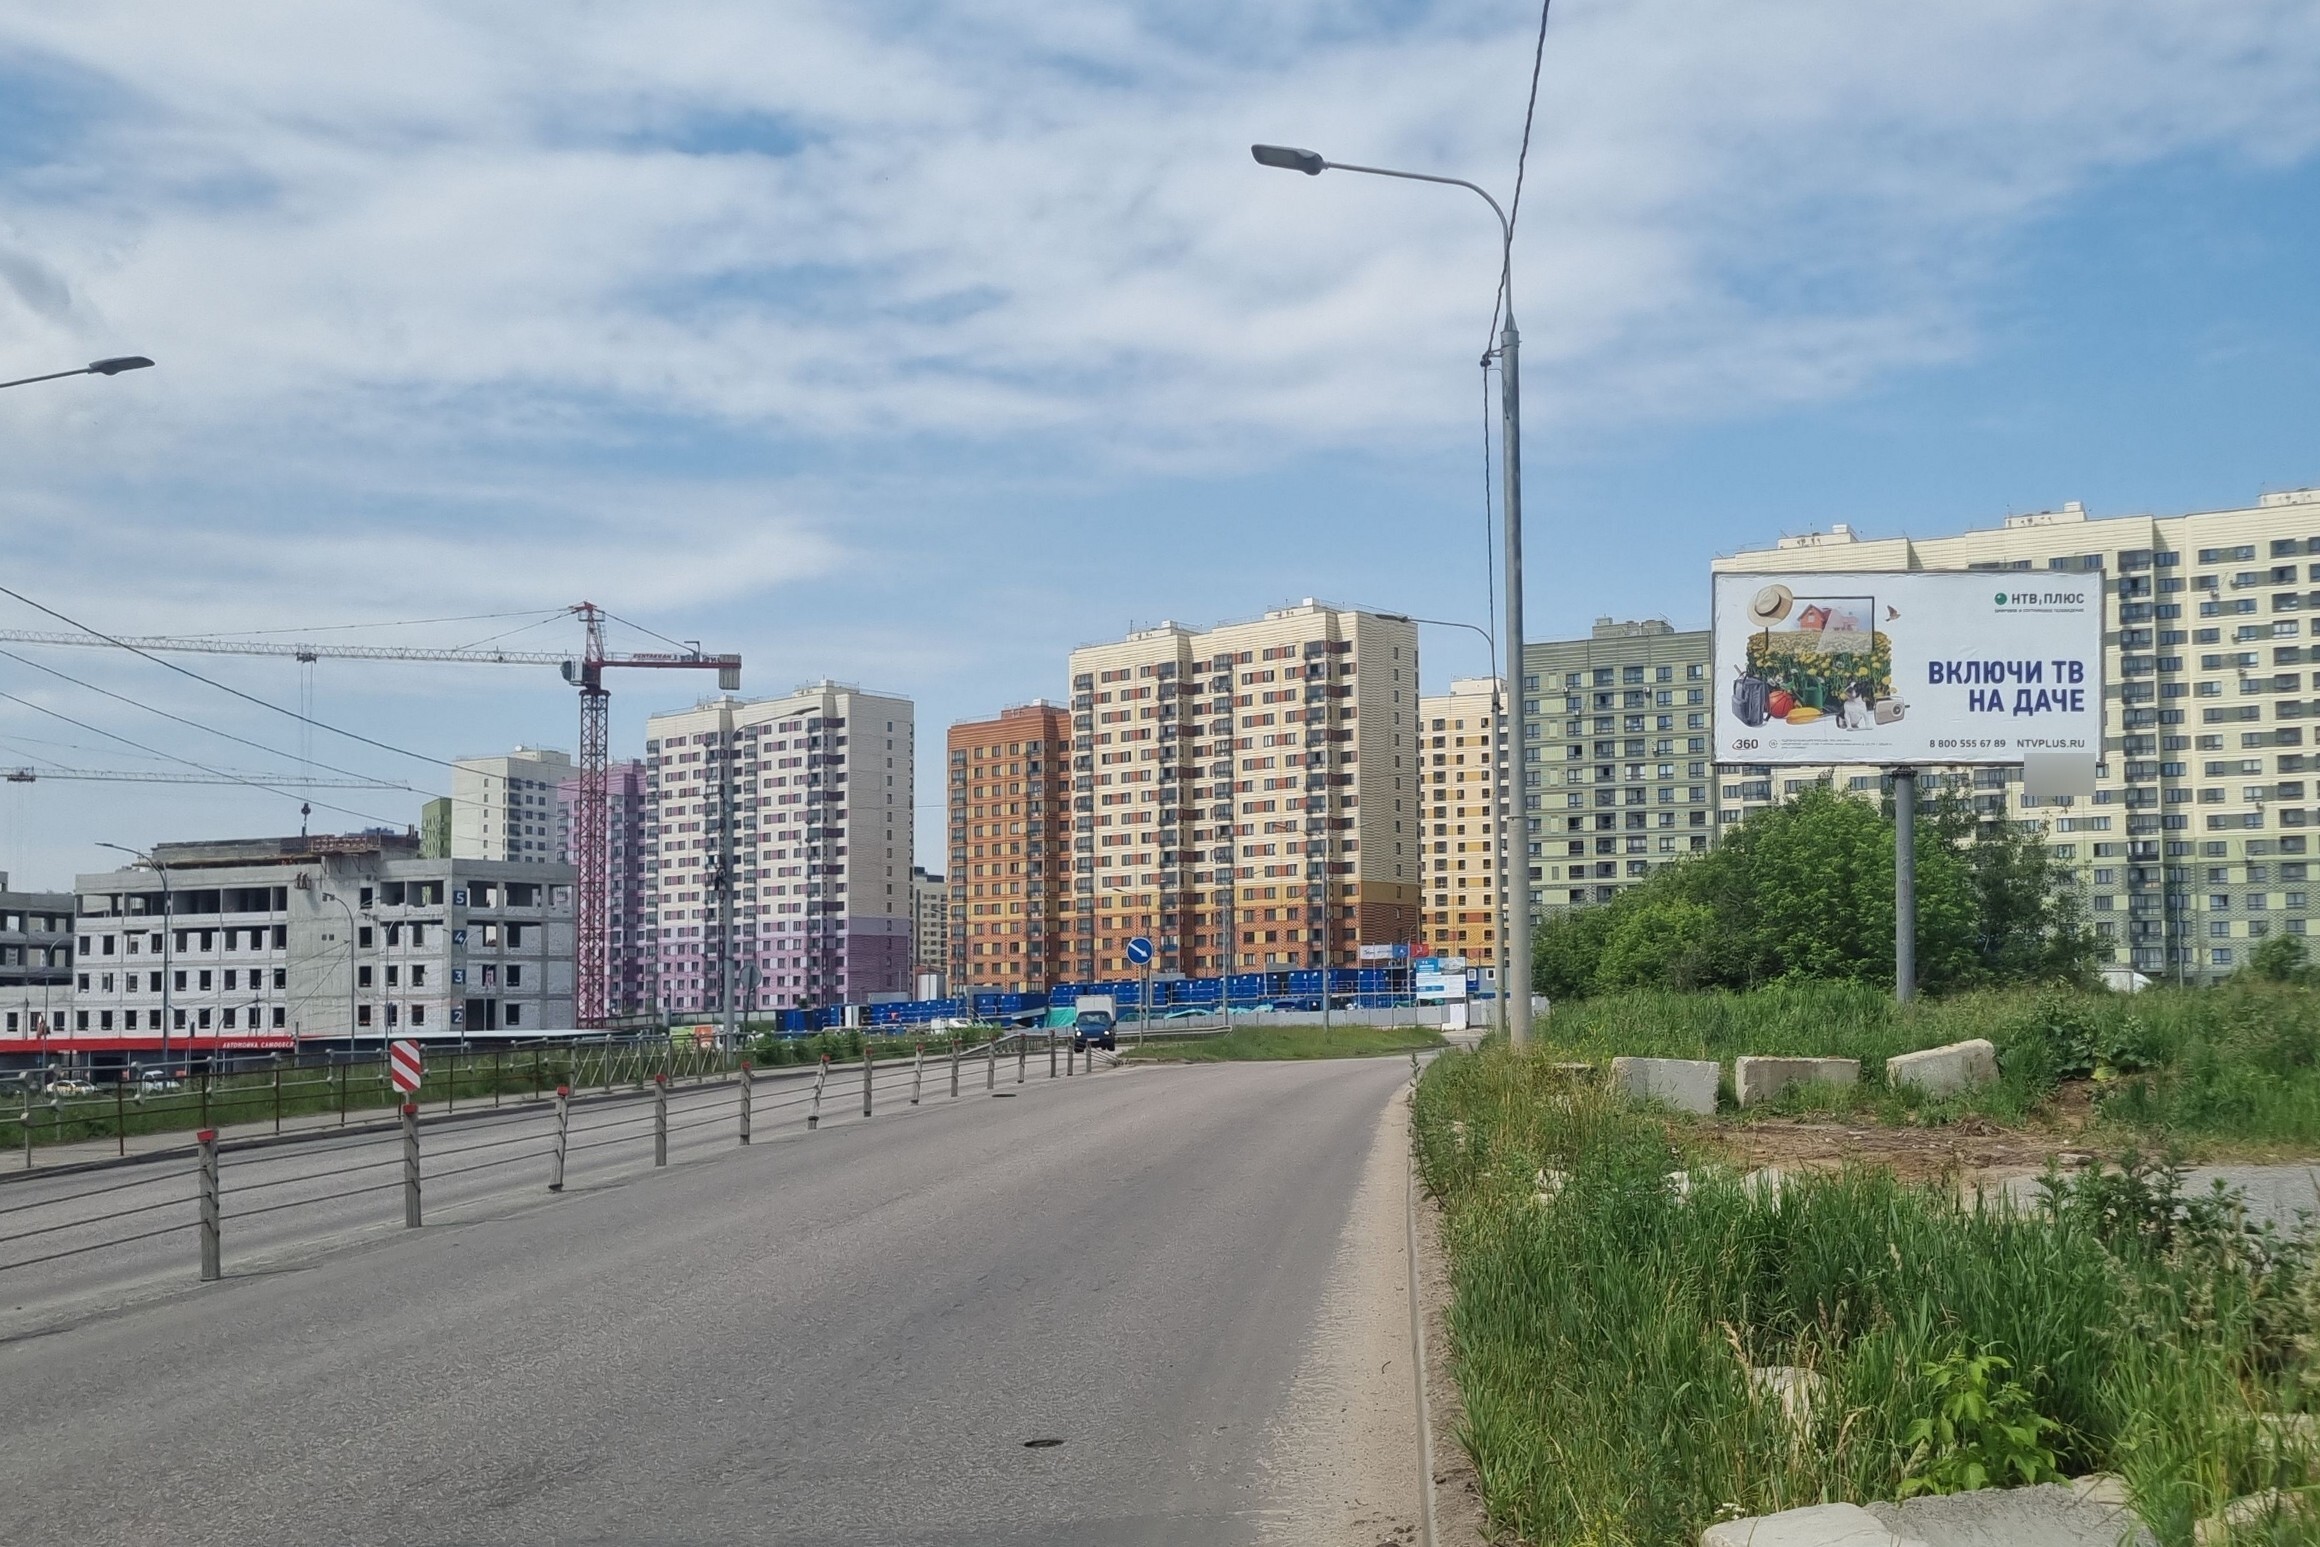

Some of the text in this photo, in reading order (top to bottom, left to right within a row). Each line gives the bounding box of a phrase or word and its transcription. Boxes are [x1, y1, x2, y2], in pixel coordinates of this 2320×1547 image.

[1928, 660, 2084, 684] ВКЛЮЧИ ТВ
[1969, 689, 2085, 717] НА ДАЧЕ
[1735, 739, 1759, 749] 360
[1929, 739, 2006, 748] 8 800 555 67 89
[2016, 739, 2085, 748] NTVPLUS.RU
[456, 892, 464, 904] 5
[455, 931, 464, 943] 4
[455, 970, 463, 982] 3
[454, 1011, 463, 1023] 2
